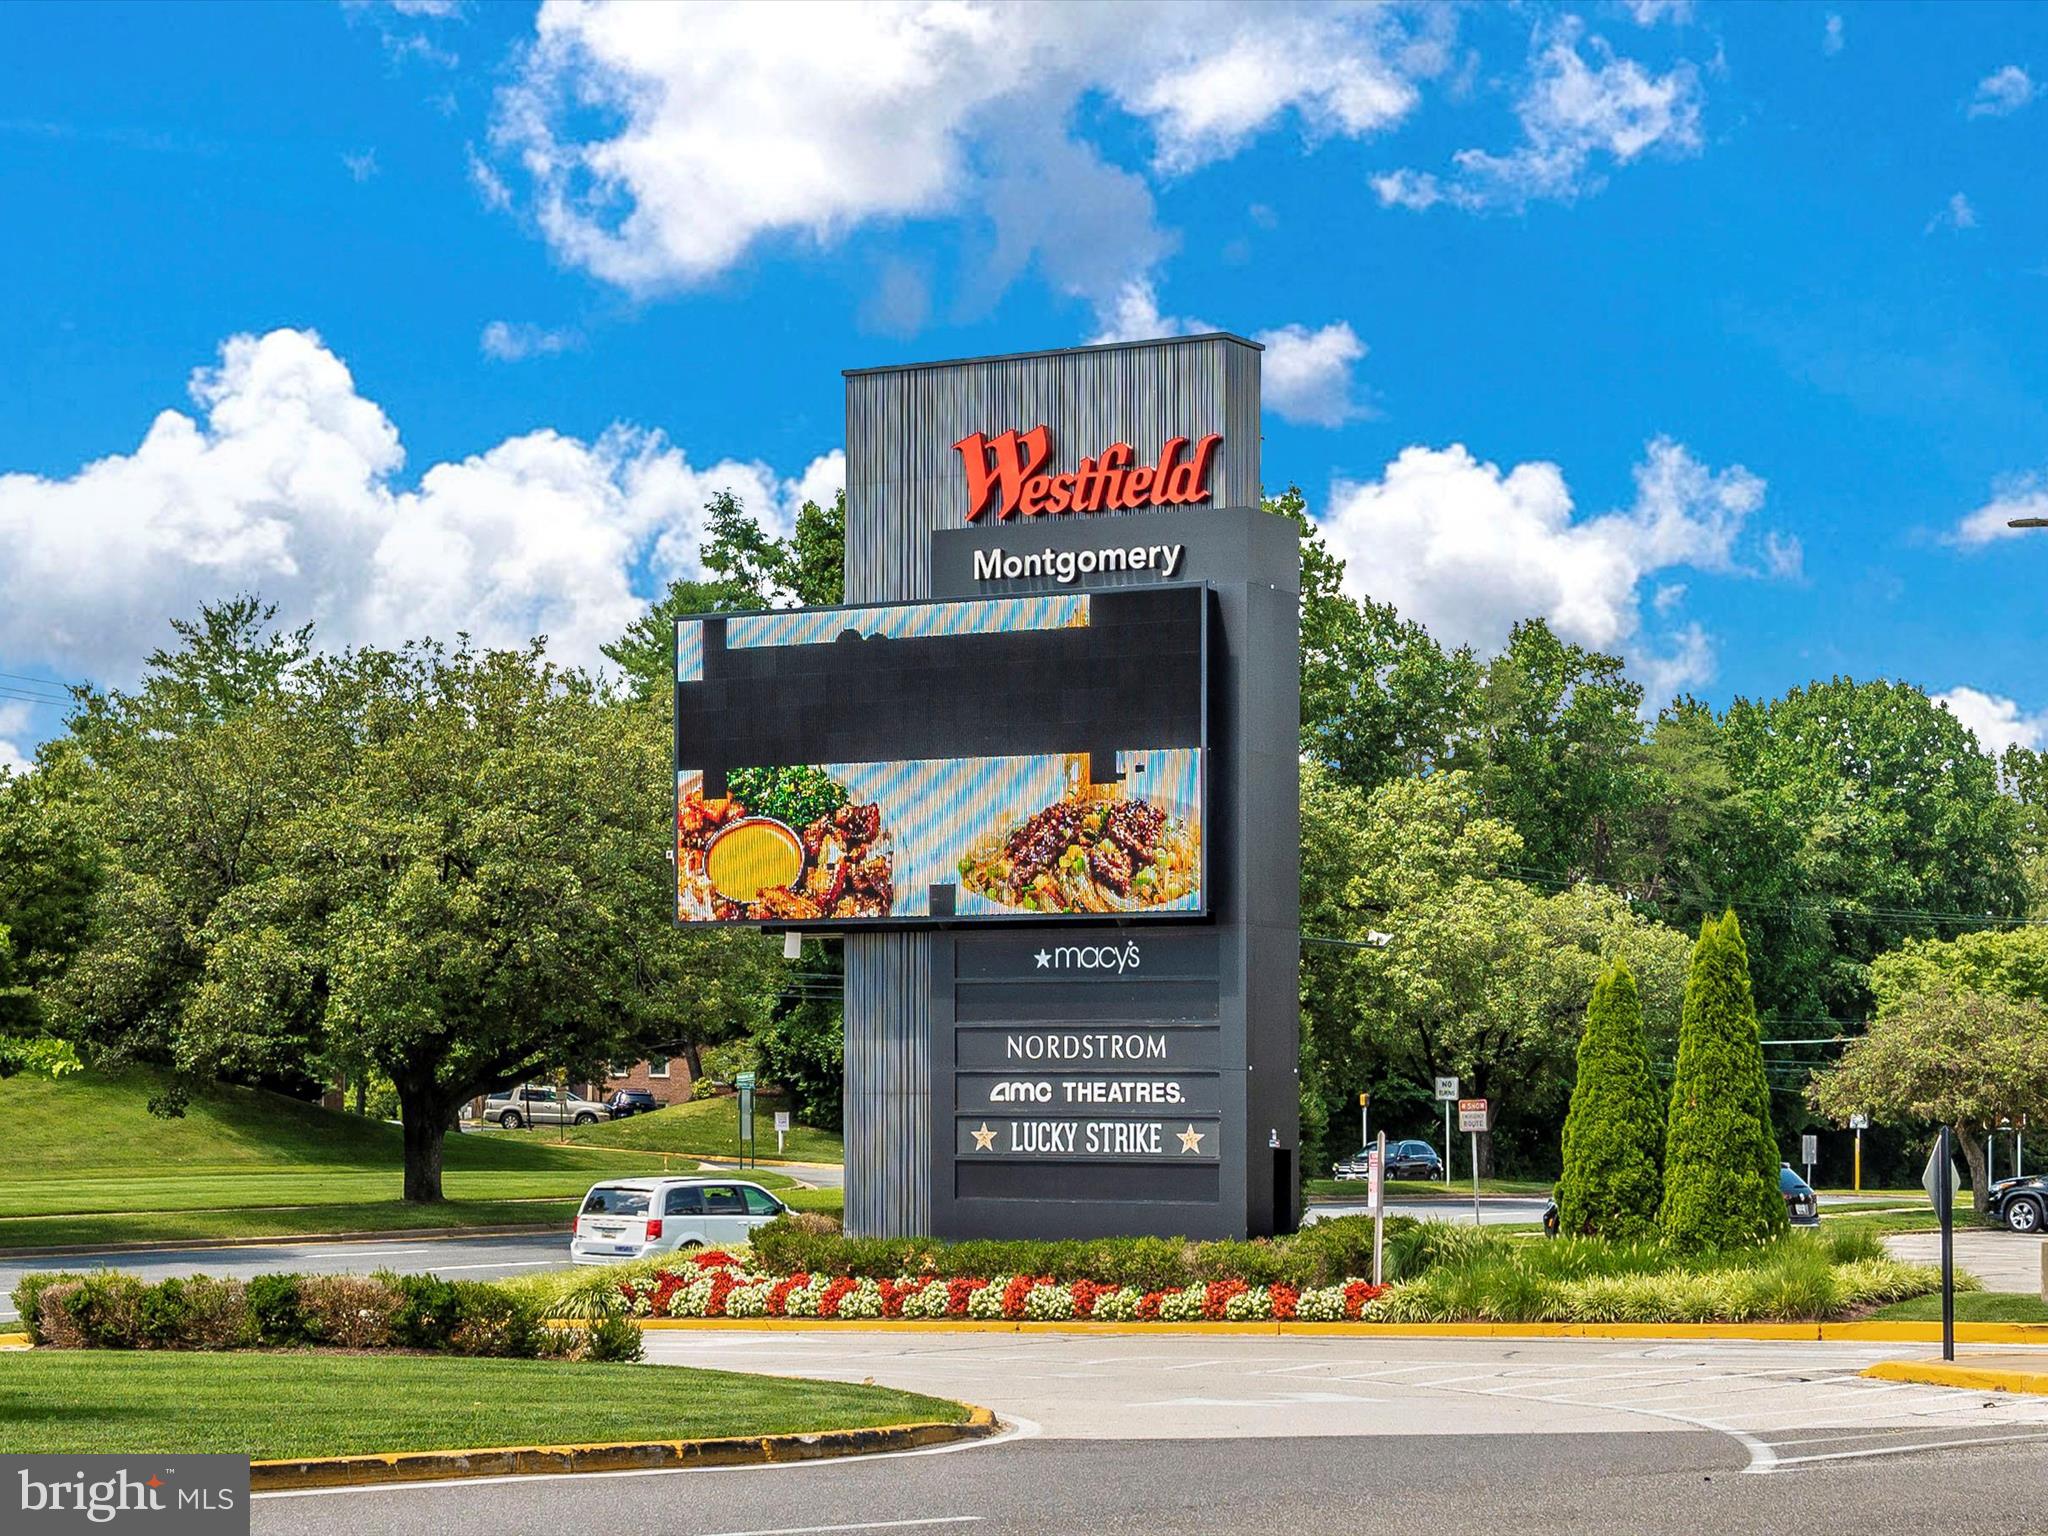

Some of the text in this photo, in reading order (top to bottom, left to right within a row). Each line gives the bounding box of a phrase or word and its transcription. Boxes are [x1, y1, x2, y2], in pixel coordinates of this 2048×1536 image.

[952, 424, 1223, 522] Westfield
[973, 544, 1182, 583] Montgomery
[1055, 940, 1140, 974] macy's
[1007, 1035, 1167, 1059] NORDSTROM
[1011, 1122, 1163, 1153] LUCKY STRIKE
